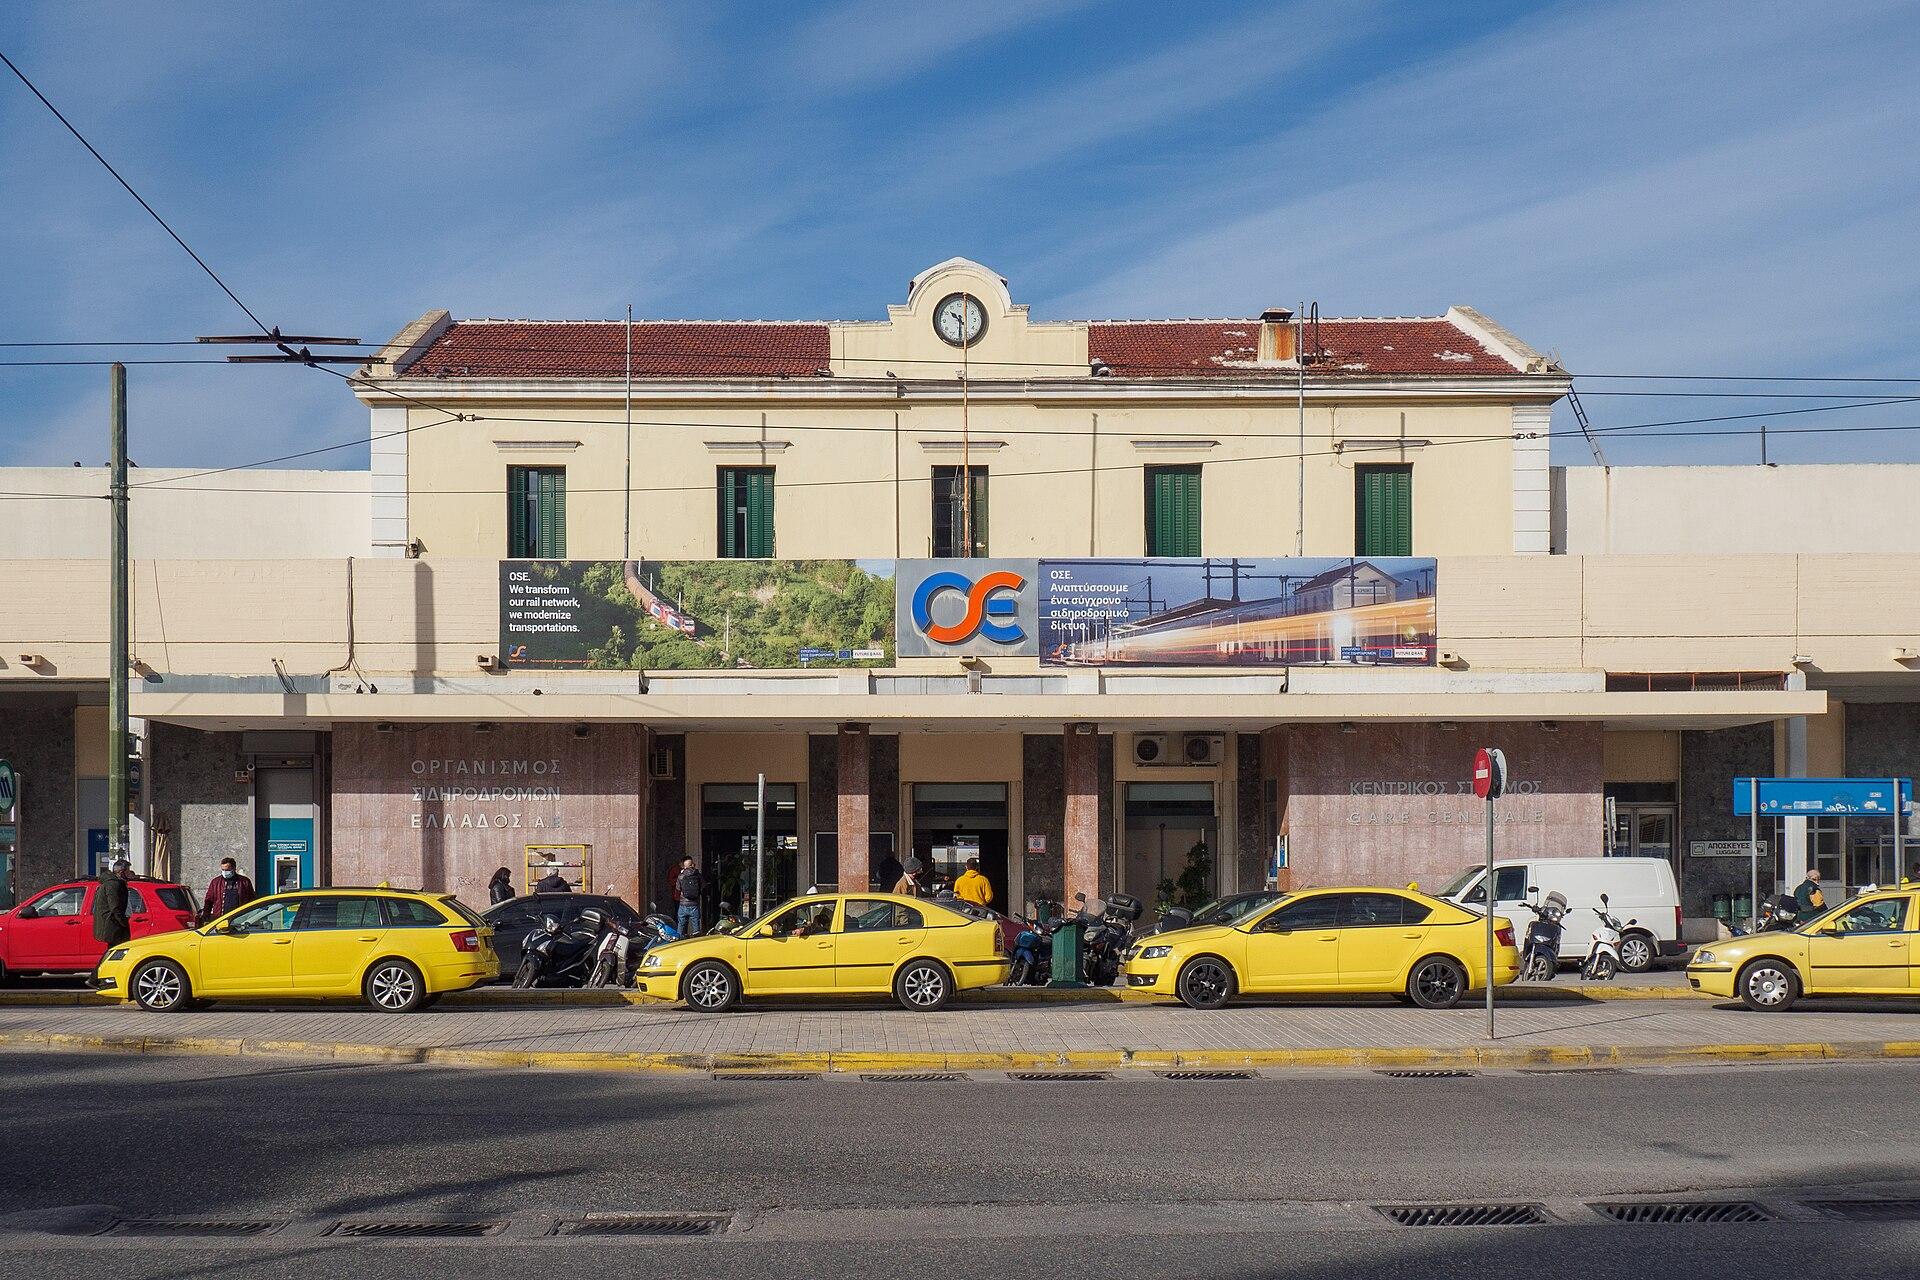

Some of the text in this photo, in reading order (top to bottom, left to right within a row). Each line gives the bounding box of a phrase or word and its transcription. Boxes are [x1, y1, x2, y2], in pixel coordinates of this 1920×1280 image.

[509, 572, 531, 581] OSE.
[1050, 570, 1073, 579] ΟΣΕ.
[509, 584, 570, 594] We transform
[1050, 583, 1129, 594] Αναπτύσσουμε
[509, 597, 581, 608] our rail network,
[1050, 595, 1121, 607] ένα σύγχρονο
[509, 610, 571, 620] we modernize
[1050, 608, 1129, 619] σιδηροδρομικό
[509, 623, 581, 633] transportations.
[1050, 620, 1088, 630] δίκτυο.
[411, 760, 560, 774] ΟΡΓΑΝΙΣΜΟΣ
[412, 786, 561, 801] ΣΙΔΗΡΟΔΡΟΜΩΝ
[1350, 781, 1542, 795] ΚΕΝΤΡΙΚΟΣ ΣΤΜΟΣ
[411, 813, 522, 828] ΕΛΛΑΔΟΣ
[1350, 811, 1542, 825] GARE CENTRALE
